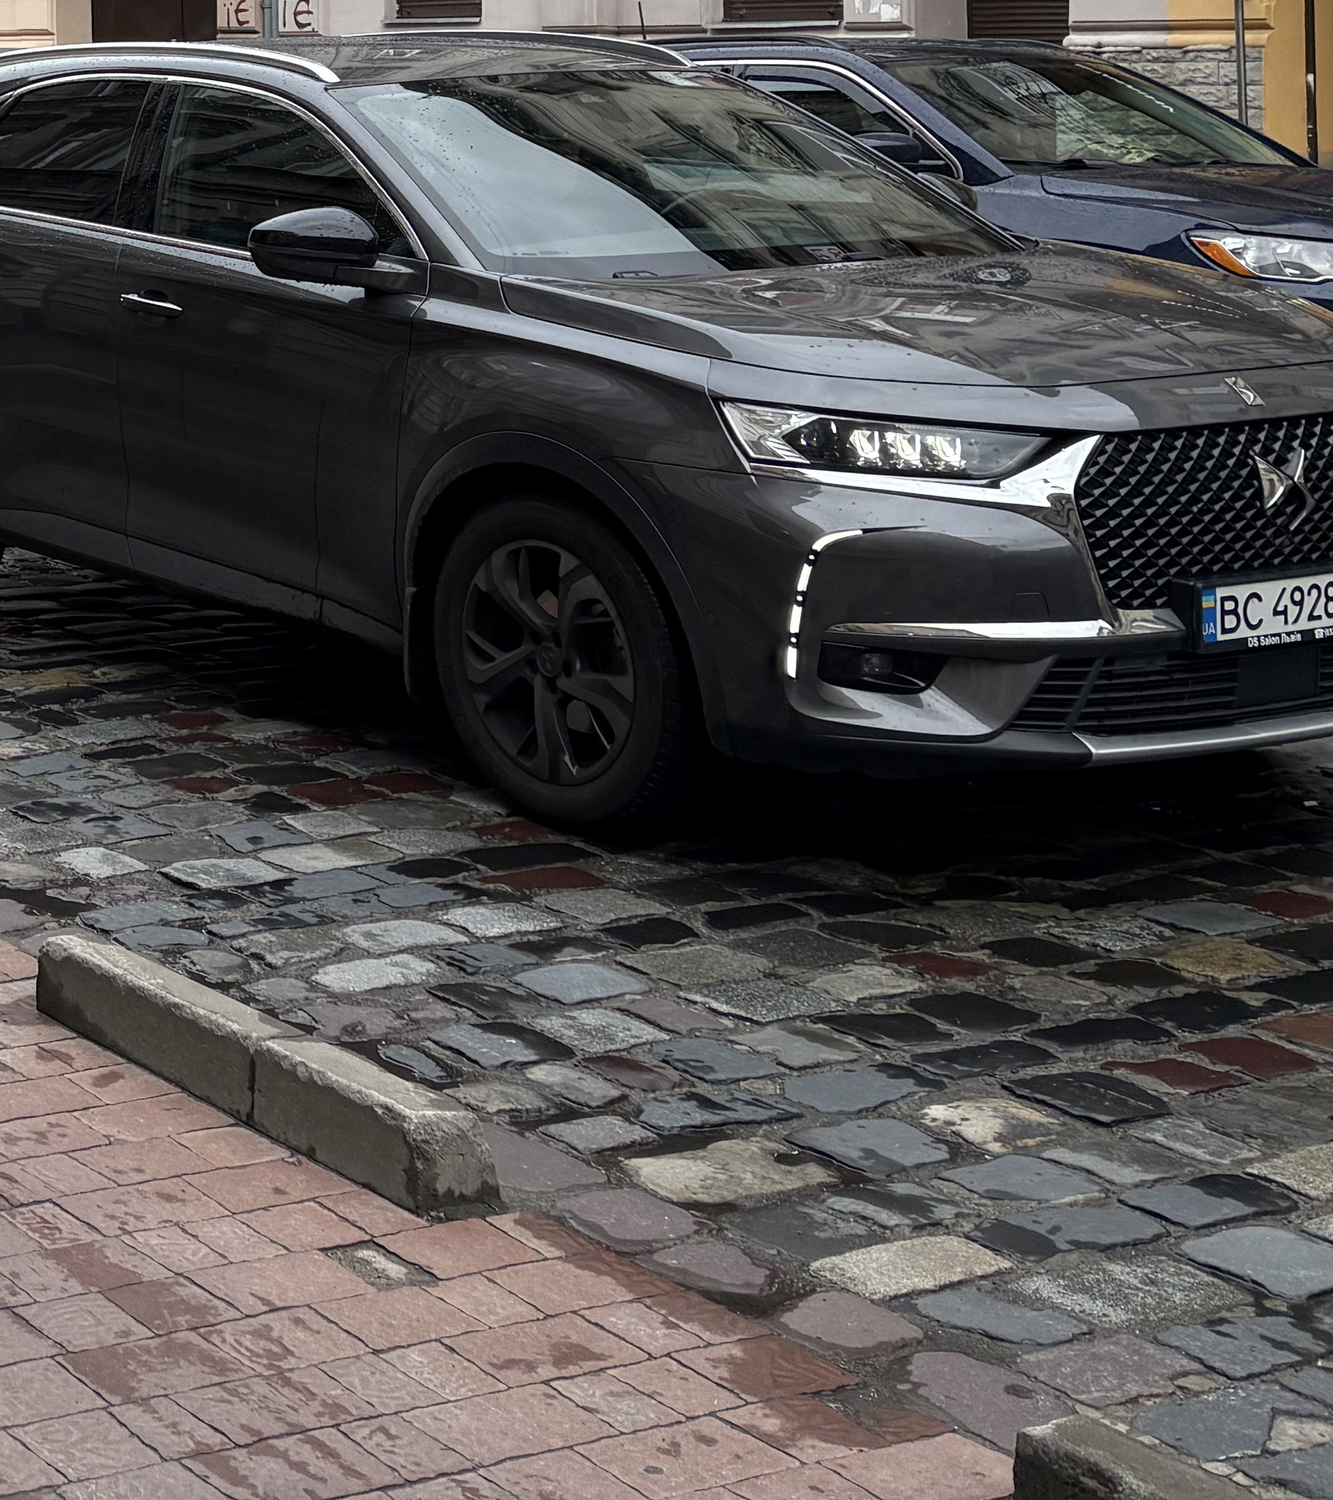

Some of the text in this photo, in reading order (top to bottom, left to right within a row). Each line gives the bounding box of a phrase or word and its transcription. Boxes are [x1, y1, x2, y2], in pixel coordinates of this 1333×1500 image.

[1202, 581, 1333, 635] UA BC 4928
[1248, 637, 1259, 648] DS
[1260, 636, 1280, 646] Salon
